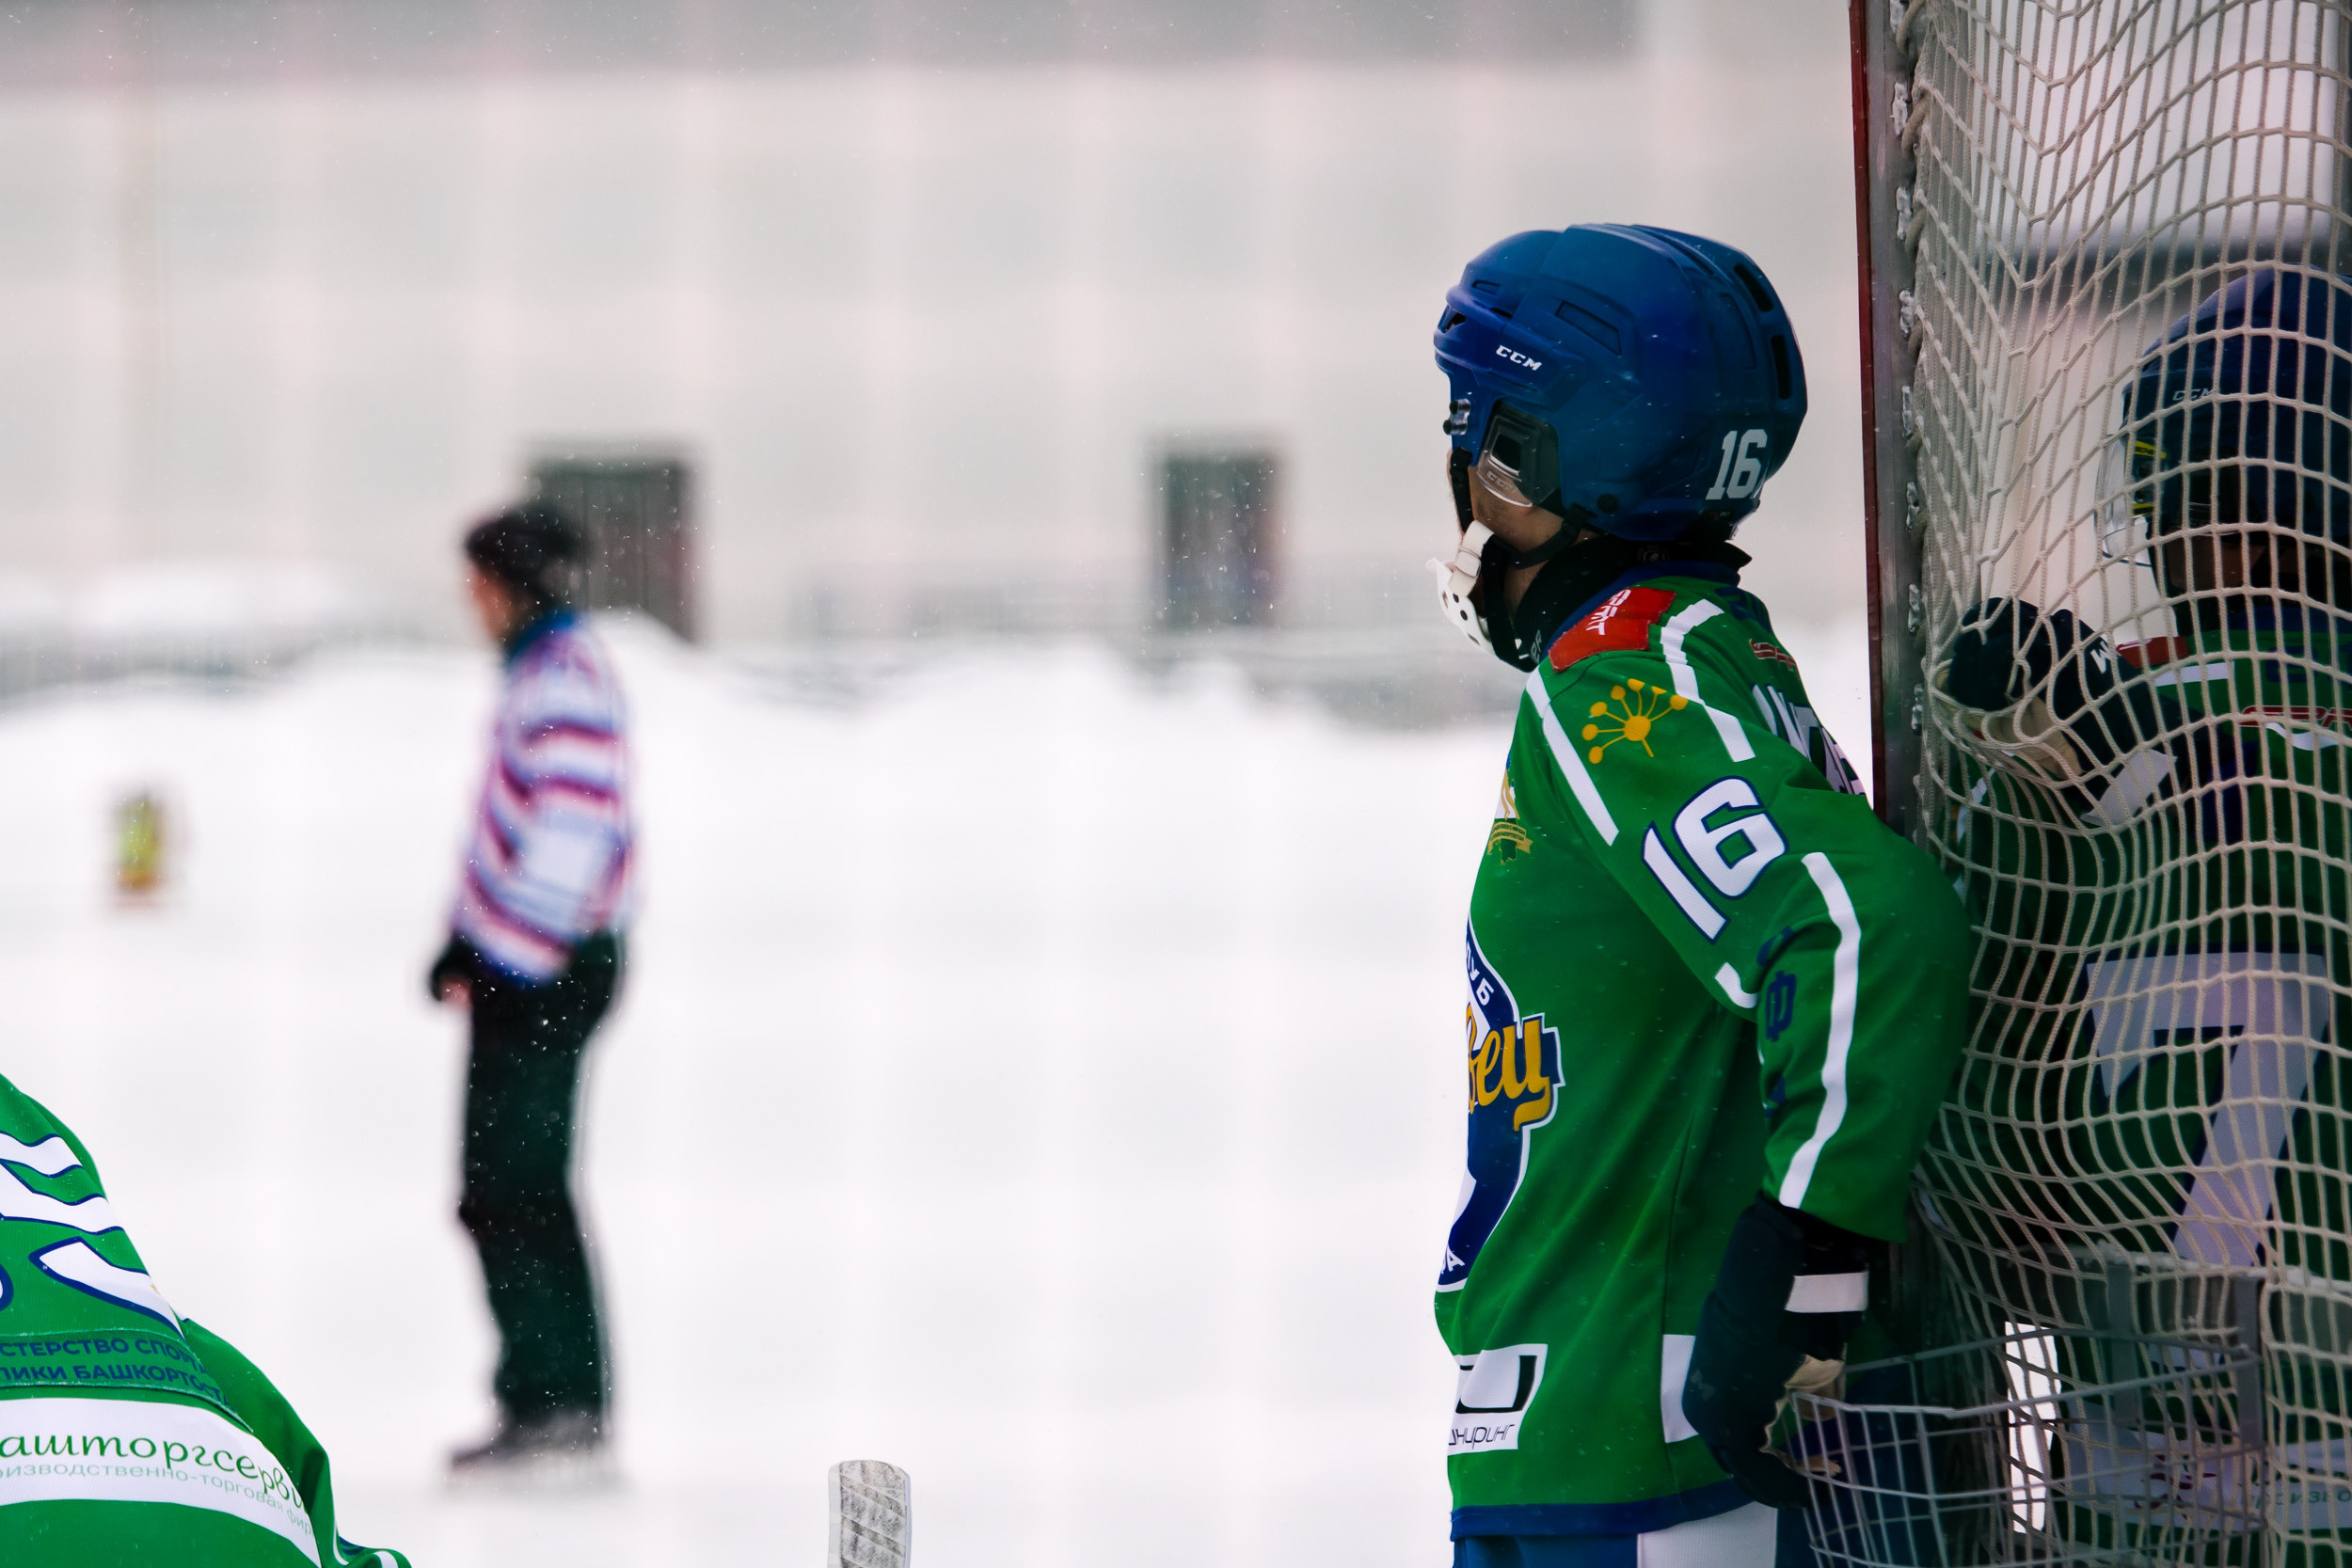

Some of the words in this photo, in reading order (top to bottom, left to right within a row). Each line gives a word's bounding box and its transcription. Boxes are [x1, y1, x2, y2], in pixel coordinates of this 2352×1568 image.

[1496, 344, 1543, 372] CCM
[1705, 428, 1769, 500] 16
[1642, 775, 1788, 945] 16
[0, 1338, 130, 1356] СТЕРСТВО
[73, 1364, 236, 1414] БАШКОРТОСТ
